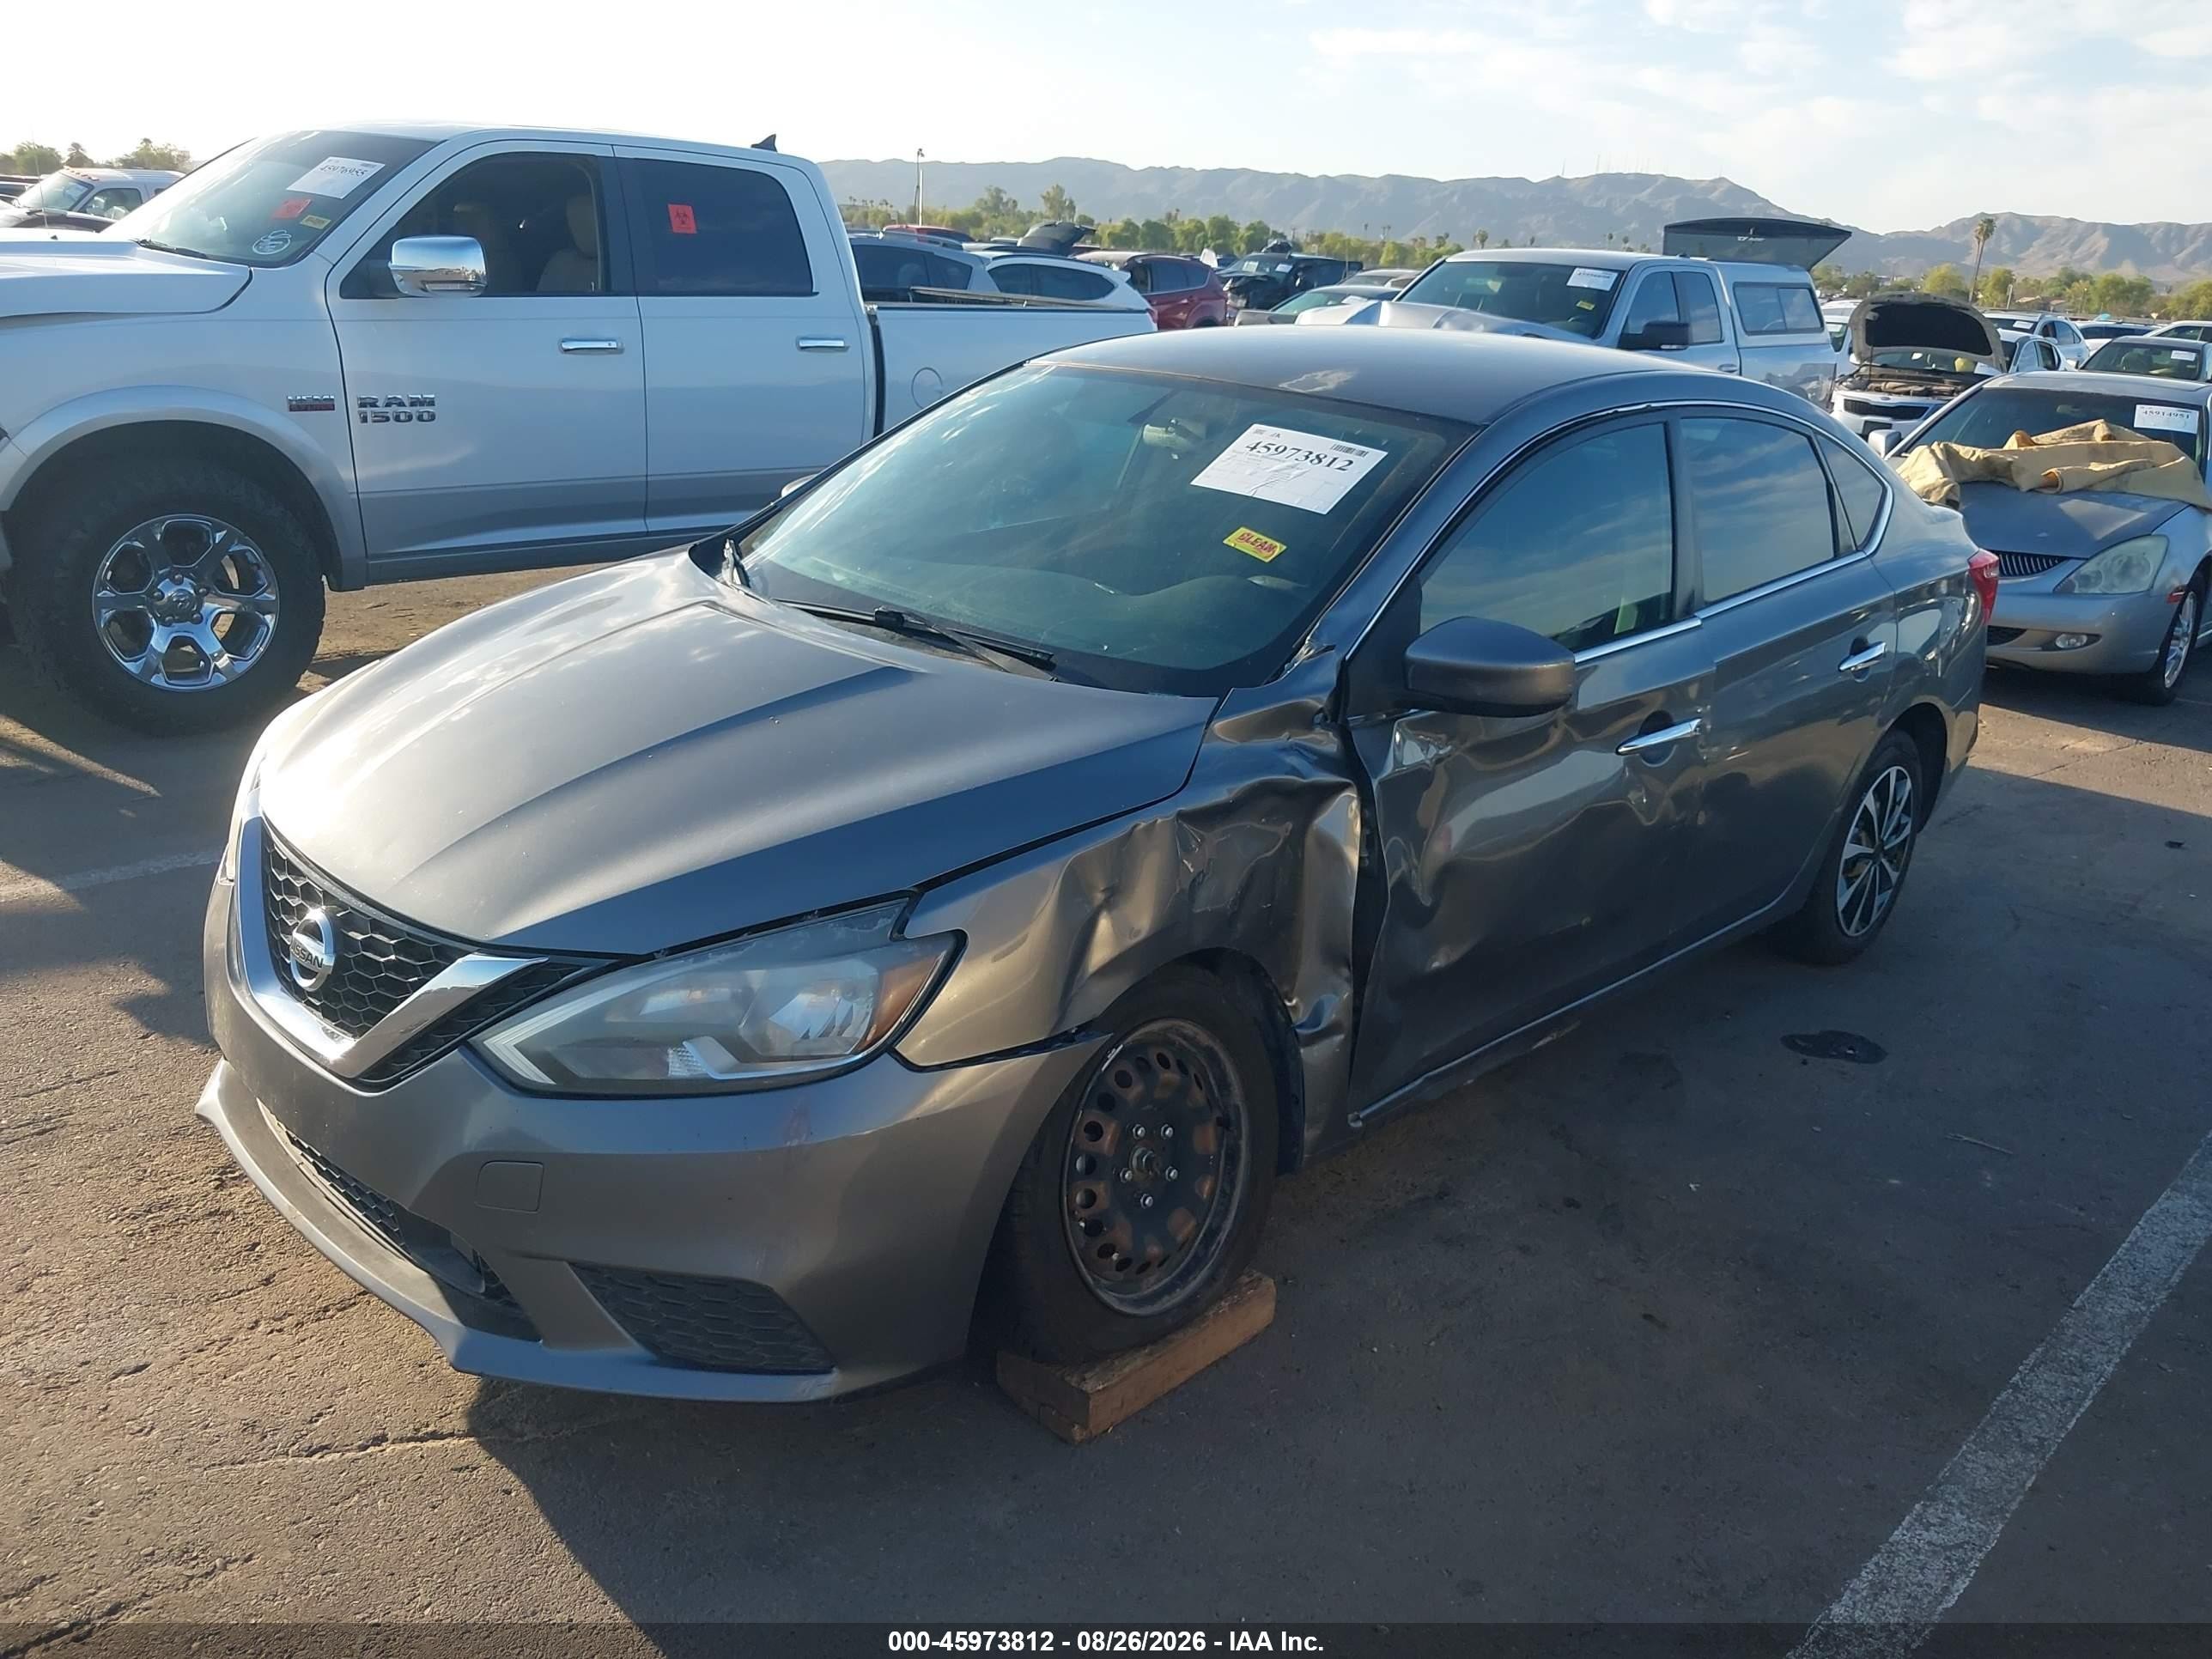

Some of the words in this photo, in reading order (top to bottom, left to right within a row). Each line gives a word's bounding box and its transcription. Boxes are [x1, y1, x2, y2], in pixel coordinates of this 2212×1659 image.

[357, 394, 436, 409] RAM
[359, 409, 436, 424] 1500
[1245, 441, 1354, 472] 45973812
[292, 940, 324, 969] ISSAN
